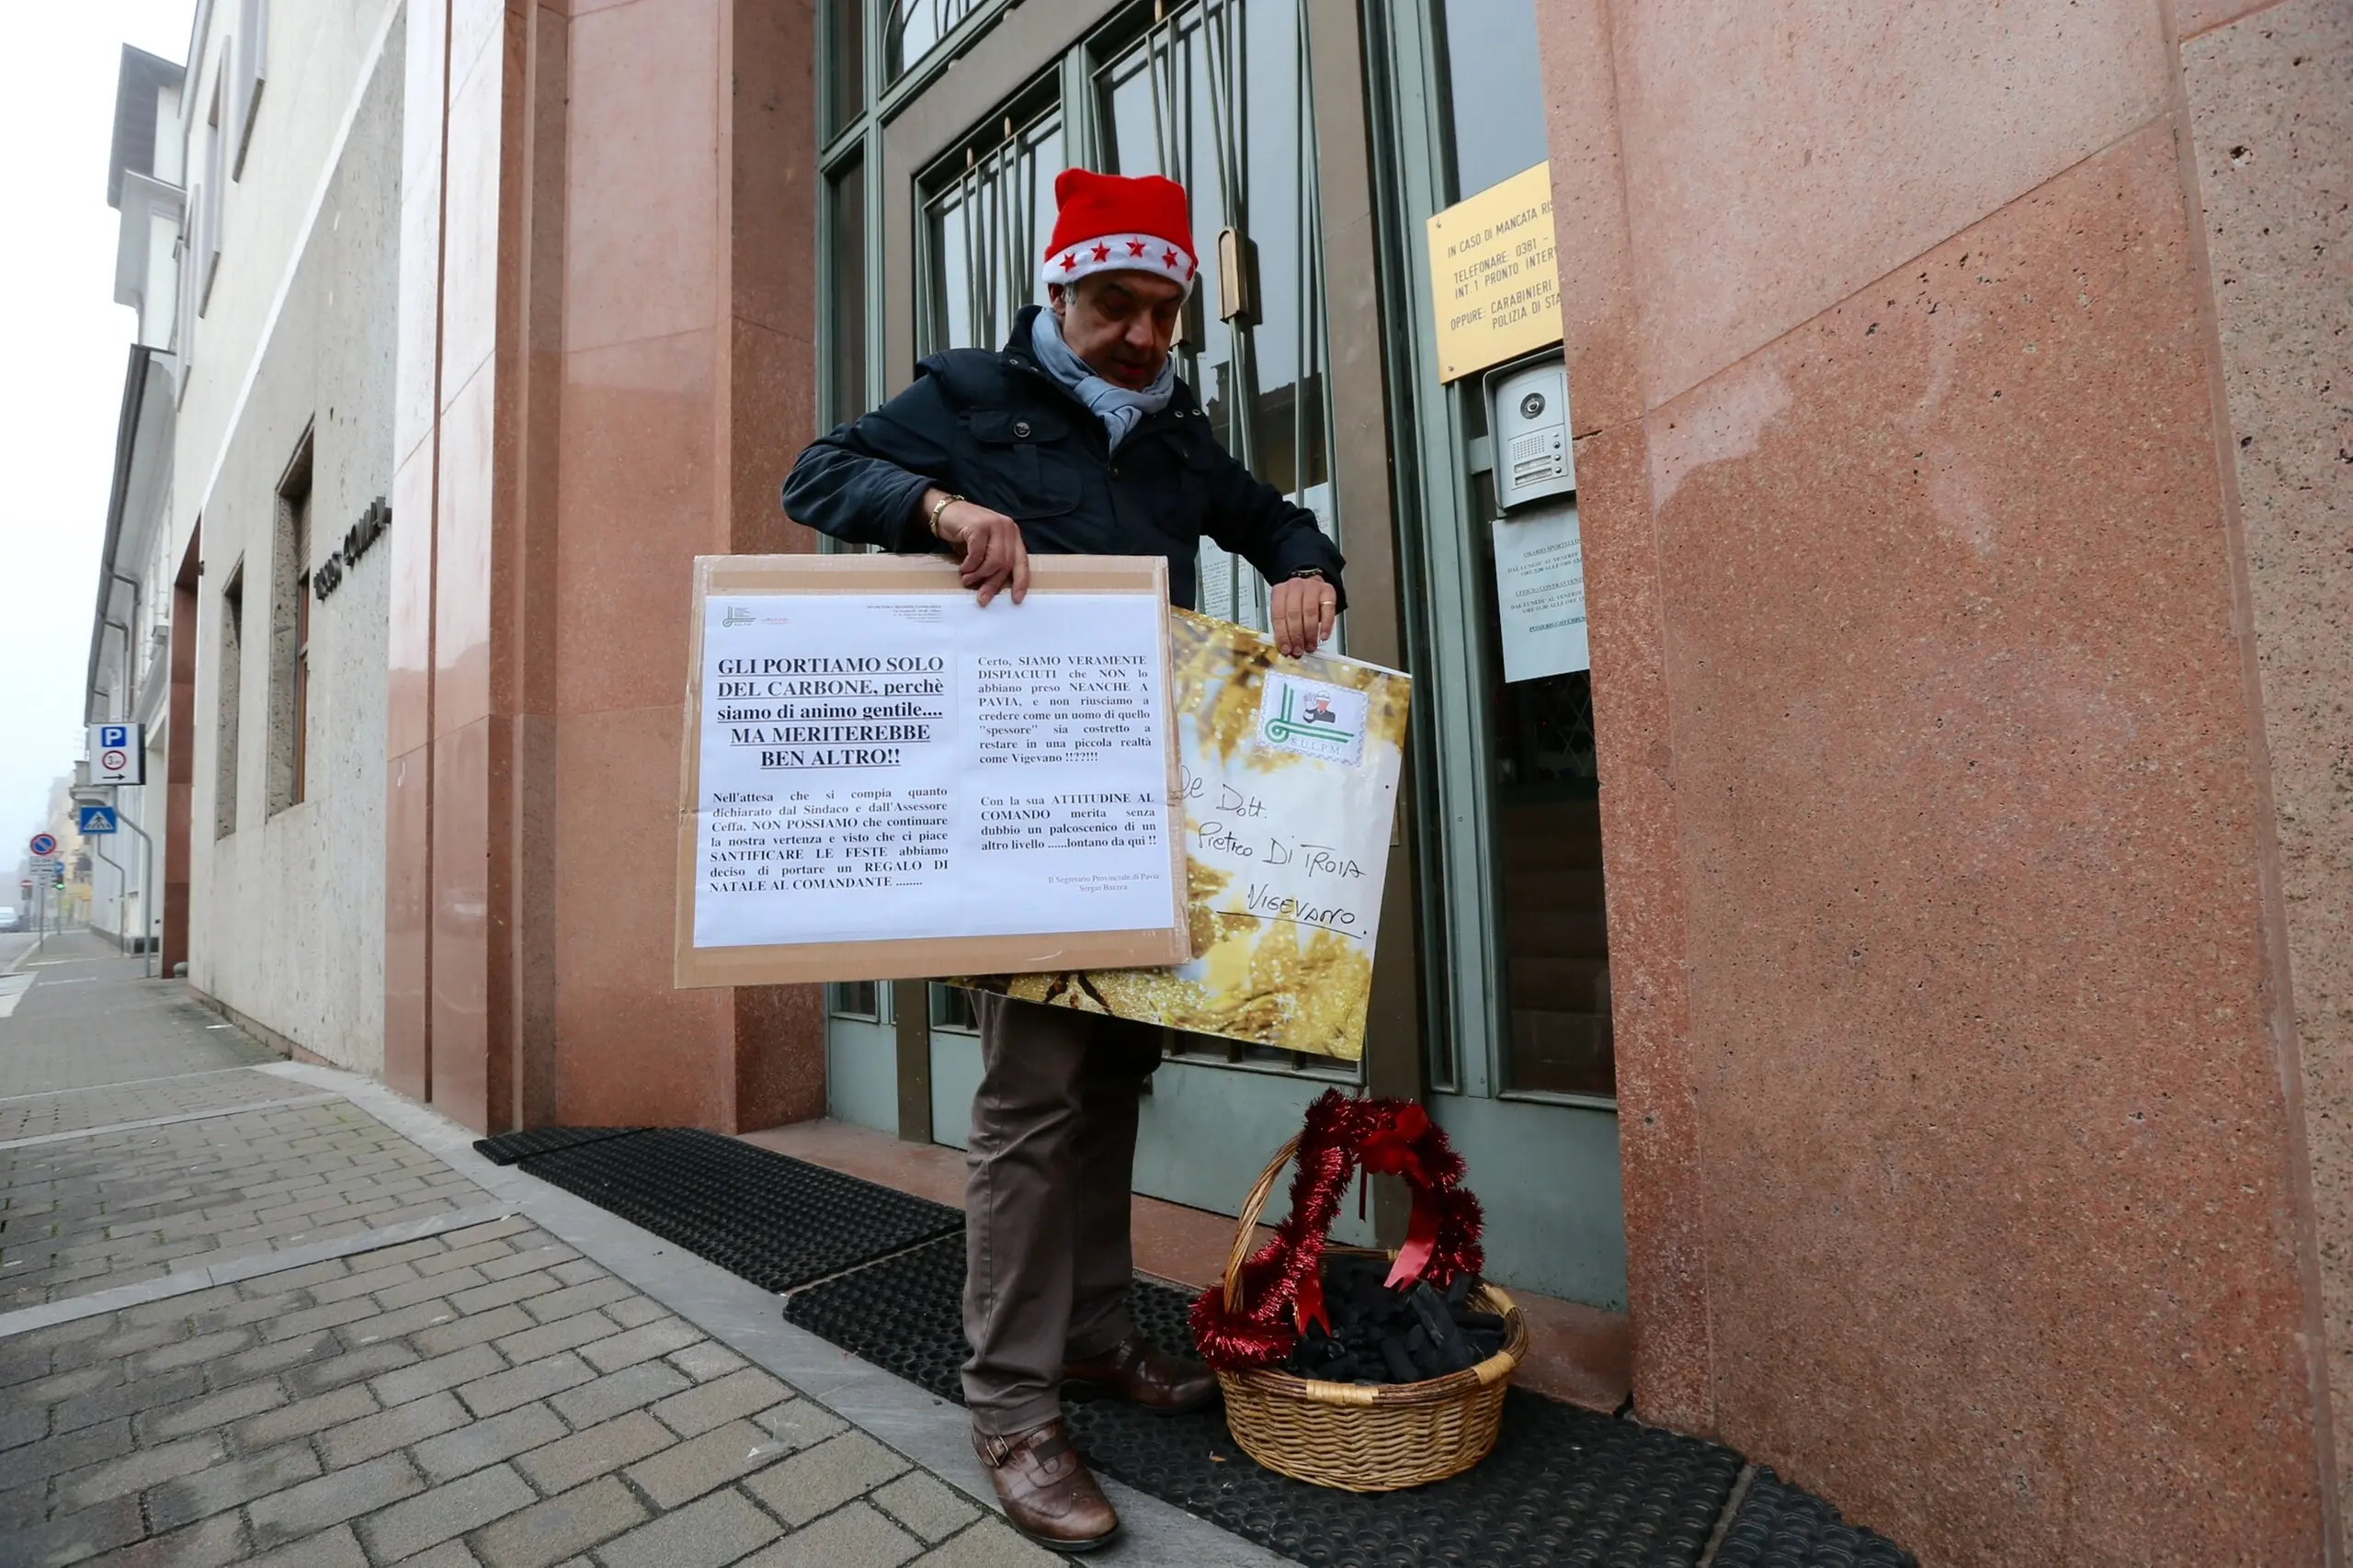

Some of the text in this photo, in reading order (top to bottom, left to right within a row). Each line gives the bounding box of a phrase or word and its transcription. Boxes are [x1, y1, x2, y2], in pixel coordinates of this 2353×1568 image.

[1448, 244, 1456, 258] IN
[1460, 233, 1482, 253] CASO
[1484, 228, 1493, 242] DI
[1495, 208, 1538, 235] MANCATA
[1454, 238, 1537, 284] TELEFONARE: 0381
[1455, 284, 1472, 301] INT.
[1474, 280, 1479, 290] 1
[1484, 262, 1519, 287] PRONTO
[1450, 279, 1552, 331] OPPURE: CARABINIERI
[1492, 306, 1528, 330] POLIZIA
[1531, 301, 1540, 314] DI
[718, 657, 944, 674] GLI PORTIAMO SOLO
[978, 655, 1147, 666] Certo, SIAMO VERAMENTE
[978, 669, 1148, 679] DISPIACIUTI che NON lo
[718, 678, 944, 697] DEL CARBONE, perchè
[978, 682, 1148, 695] abbiano preso NEANCHE A
[979, 697, 1022, 707] PAVIA,
[1080, 696, 1132, 706] riusciamo
[717, 706, 772, 722] siamo
[777, 704, 794, 721] di
[800, 703, 857, 720] animo
[978, 711, 1020, 721] credere
[1022, 712, 1051, 721] come
[1071, 710, 1101, 720] uomo
[1104, 710, 1115, 719] di
[1118, 710, 1151, 722] quello
[106, 729, 122, 745] P
[731, 724, 930, 744] MA MERITEREBBE
[1053, 724, 1068, 734] sia
[1083, 724, 1131, 734] costretto
[980, 740, 1018, 749] restare
[1026, 739, 1037, 749] in
[1074, 738, 1112, 749] piccola
[1120, 737, 1152, 746] realtà
[1290, 738, 1343, 756] S.U.L.P.M.
[761, 748, 900, 767] BEN ALTRO!!
[979, 754, 1008, 764] come
[1011, 753, 1063, 765] Vigevano
[713, 788, 948, 804] Nell'attesa che si compia quanto
[981, 797, 1004, 806] Con
[1009, 796, 1020, 805] la
[1051, 794, 1131, 804] ATTITUDINE
[1137, 793, 1154, 802] AL
[710, 807, 772, 818] dichiarato
[779, 805, 797, 815] dal
[803, 804, 849, 815] Sindaco
[868, 802, 948, 812] dall'Assessore
[981, 810, 1051, 821] COMANDO
[1070, 809, 1107, 818] merita
[751, 821, 781, 831] NON
[787, 818, 858, 829] POSSIAMO
[862, 817, 882, 827] che
[886, 816, 948, 826] continuare
[981, 824, 1020, 835] dubbio
[1028, 826, 1042, 835] un
[1050, 823, 1118, 835] palcoscenico
[1124, 823, 1135, 832] di
[711, 831, 949, 847] la nostra vertenza e visto che ci piace
[982, 840, 1010, 850] altro
[1011, 839, 1045, 849] livello
[1110, 836, 1125, 846] da
[1128, 835, 1145, 848] qui
[710, 846, 949, 862] SANTIFICARE LE FESTE abbiamo
[1300, 844, 1366, 878] TROIA
[710, 867, 745, 878] deciso
[757, 865, 768, 876] di
[781, 866, 825, 877] portare
[864, 860, 922, 872] REGALO
[934, 859, 949, 869] DI
[710, 881, 767, 892] NATALE
[770, 880, 789, 891] AL
[792, 877, 892, 890] COMANDANTE
[1056, 875, 1091, 885] Segretario
[1092, 874, 1130, 882] Provinciale
[1141, 872, 1160, 881] Pavia
[1079, 884, 1101, 892] Sergio
